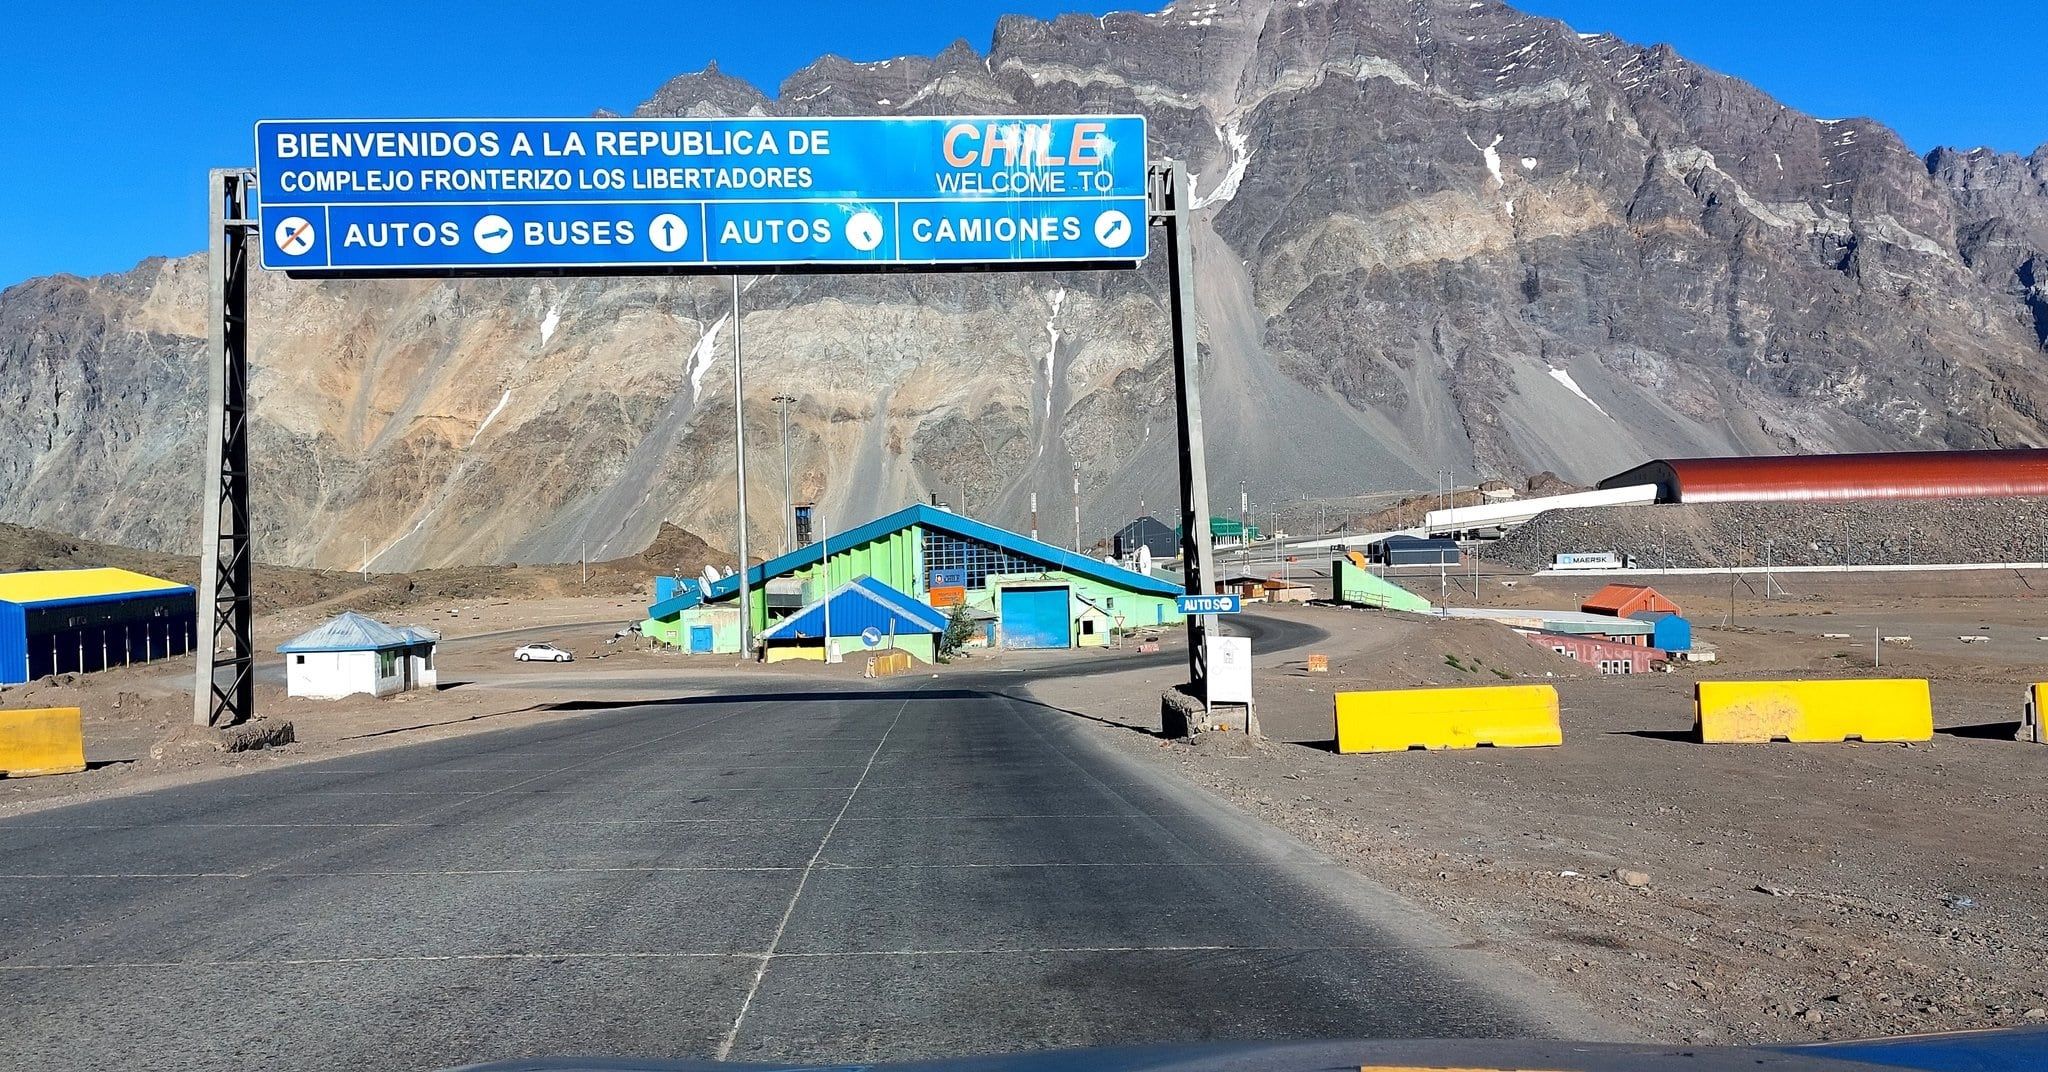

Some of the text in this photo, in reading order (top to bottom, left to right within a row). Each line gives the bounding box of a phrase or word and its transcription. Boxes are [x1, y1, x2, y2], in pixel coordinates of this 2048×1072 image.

[277, 130, 830, 158] BIENVENIDOS A LA REPUBLICA DE
[943, 122, 1106, 168] CHILE
[280, 167, 813, 192] COMPLEJO FRONTERIZO LOS LIBERTADORES
[936, 171, 1113, 193] WELCOME TO
[343, 220, 635, 247] AUTOS BUSES
[720, 219, 831, 244] AUTOS
[912, 217, 1081, 242] CAMIONES
[1184, 599, 1220, 611] AUTOS
